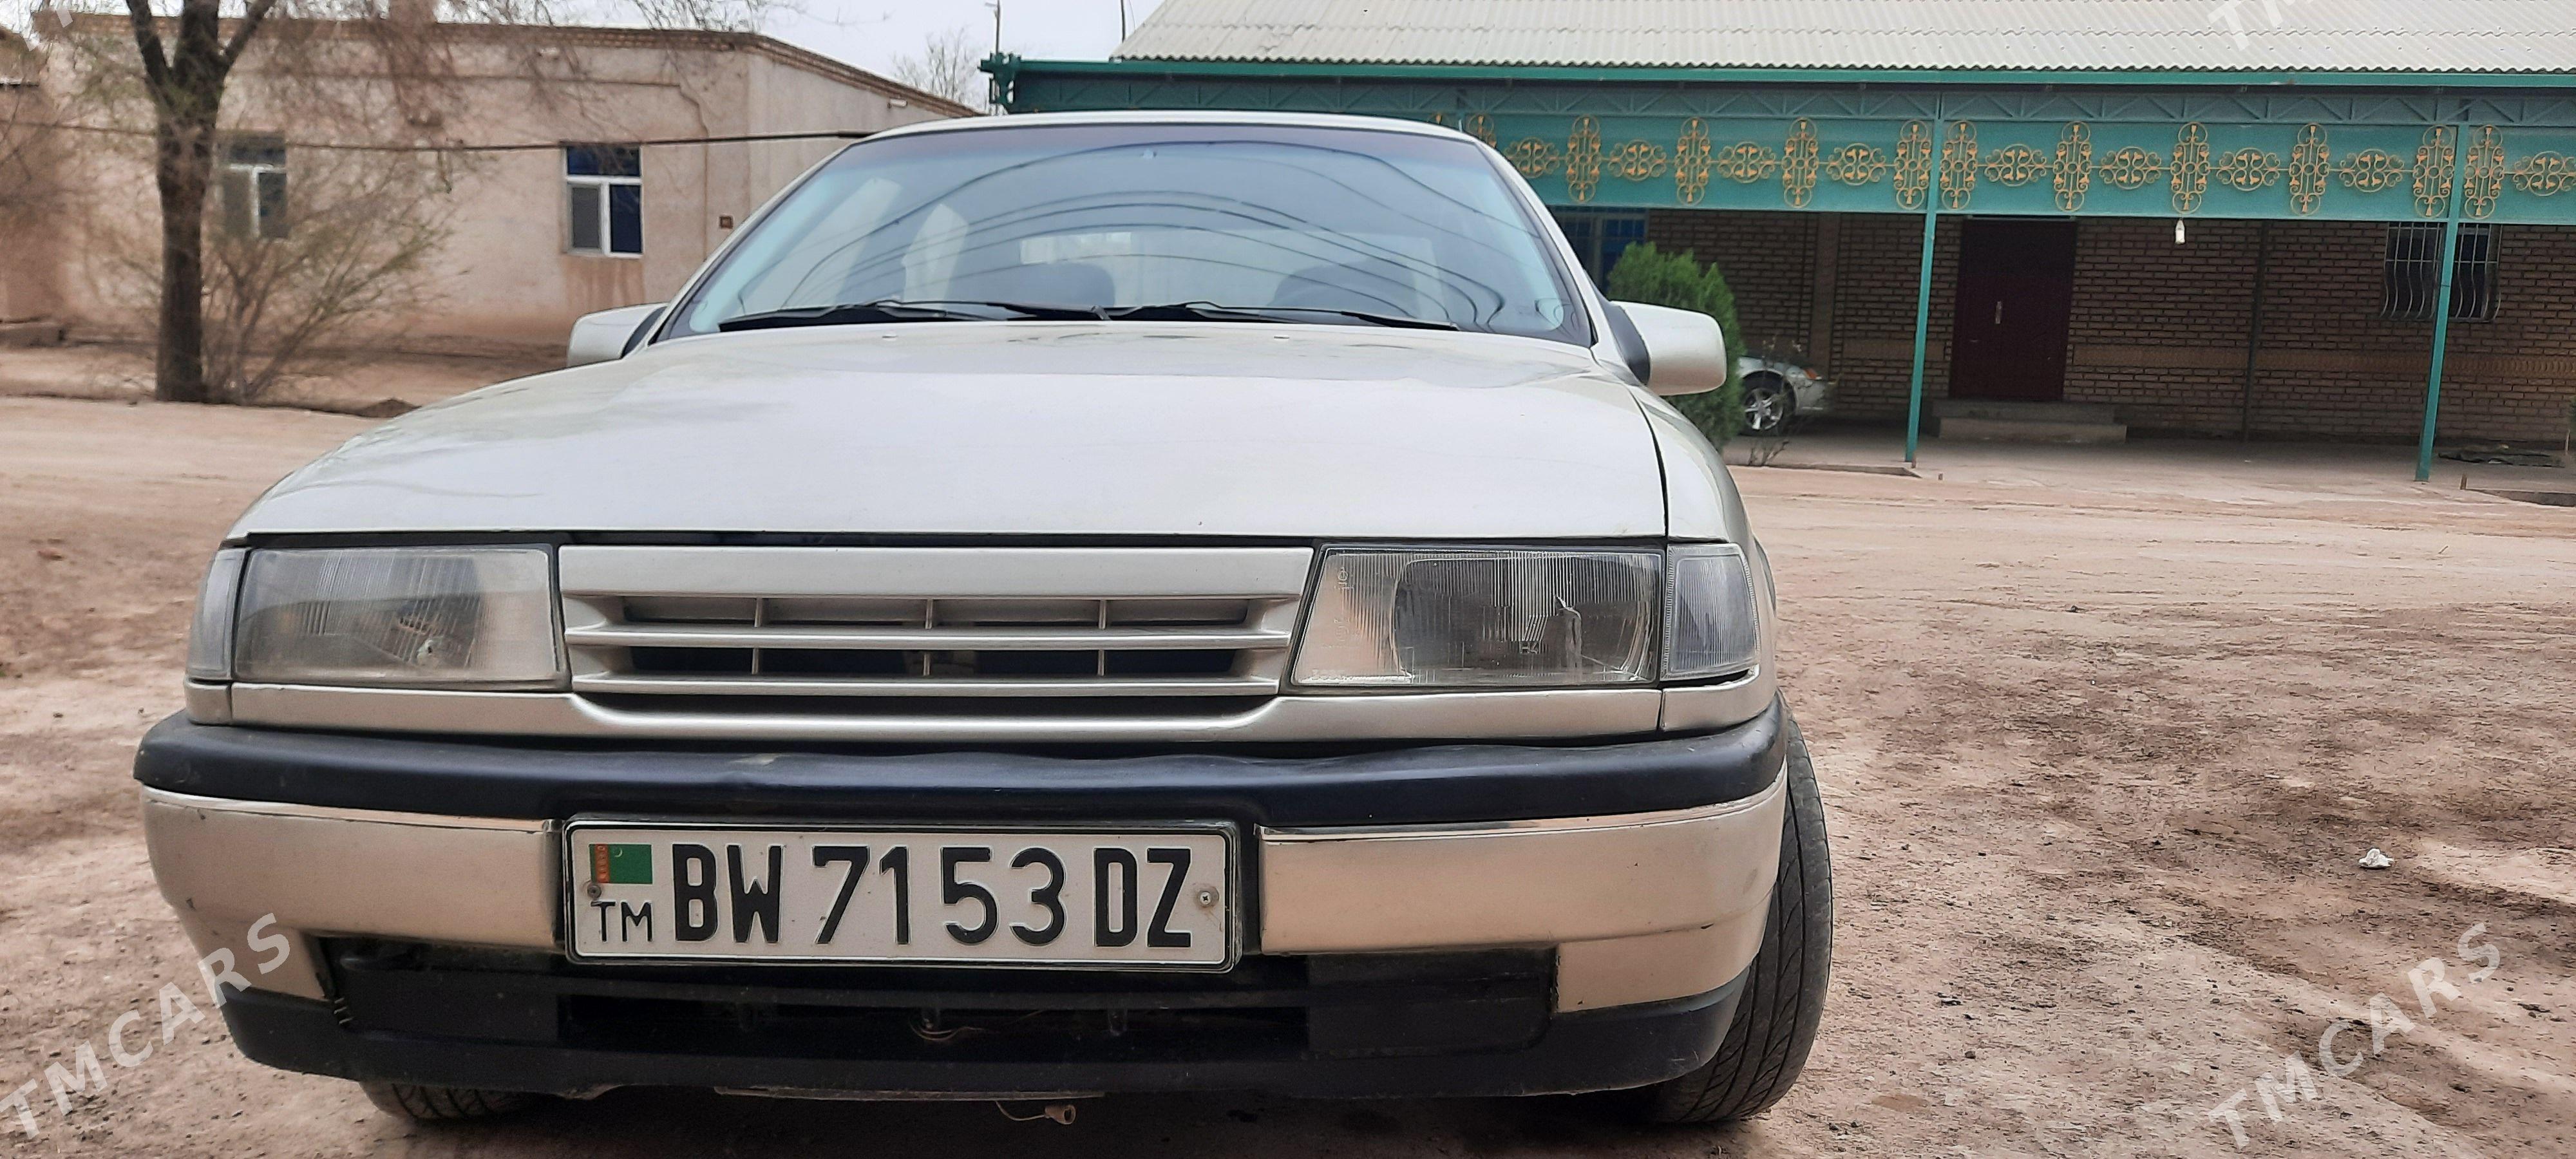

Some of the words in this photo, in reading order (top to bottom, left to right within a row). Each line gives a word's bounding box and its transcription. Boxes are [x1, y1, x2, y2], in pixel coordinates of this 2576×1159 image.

[590, 901, 653, 942] TM
[672, 843, 782, 944] BW
[1094, 847, 1192, 948] DZ
